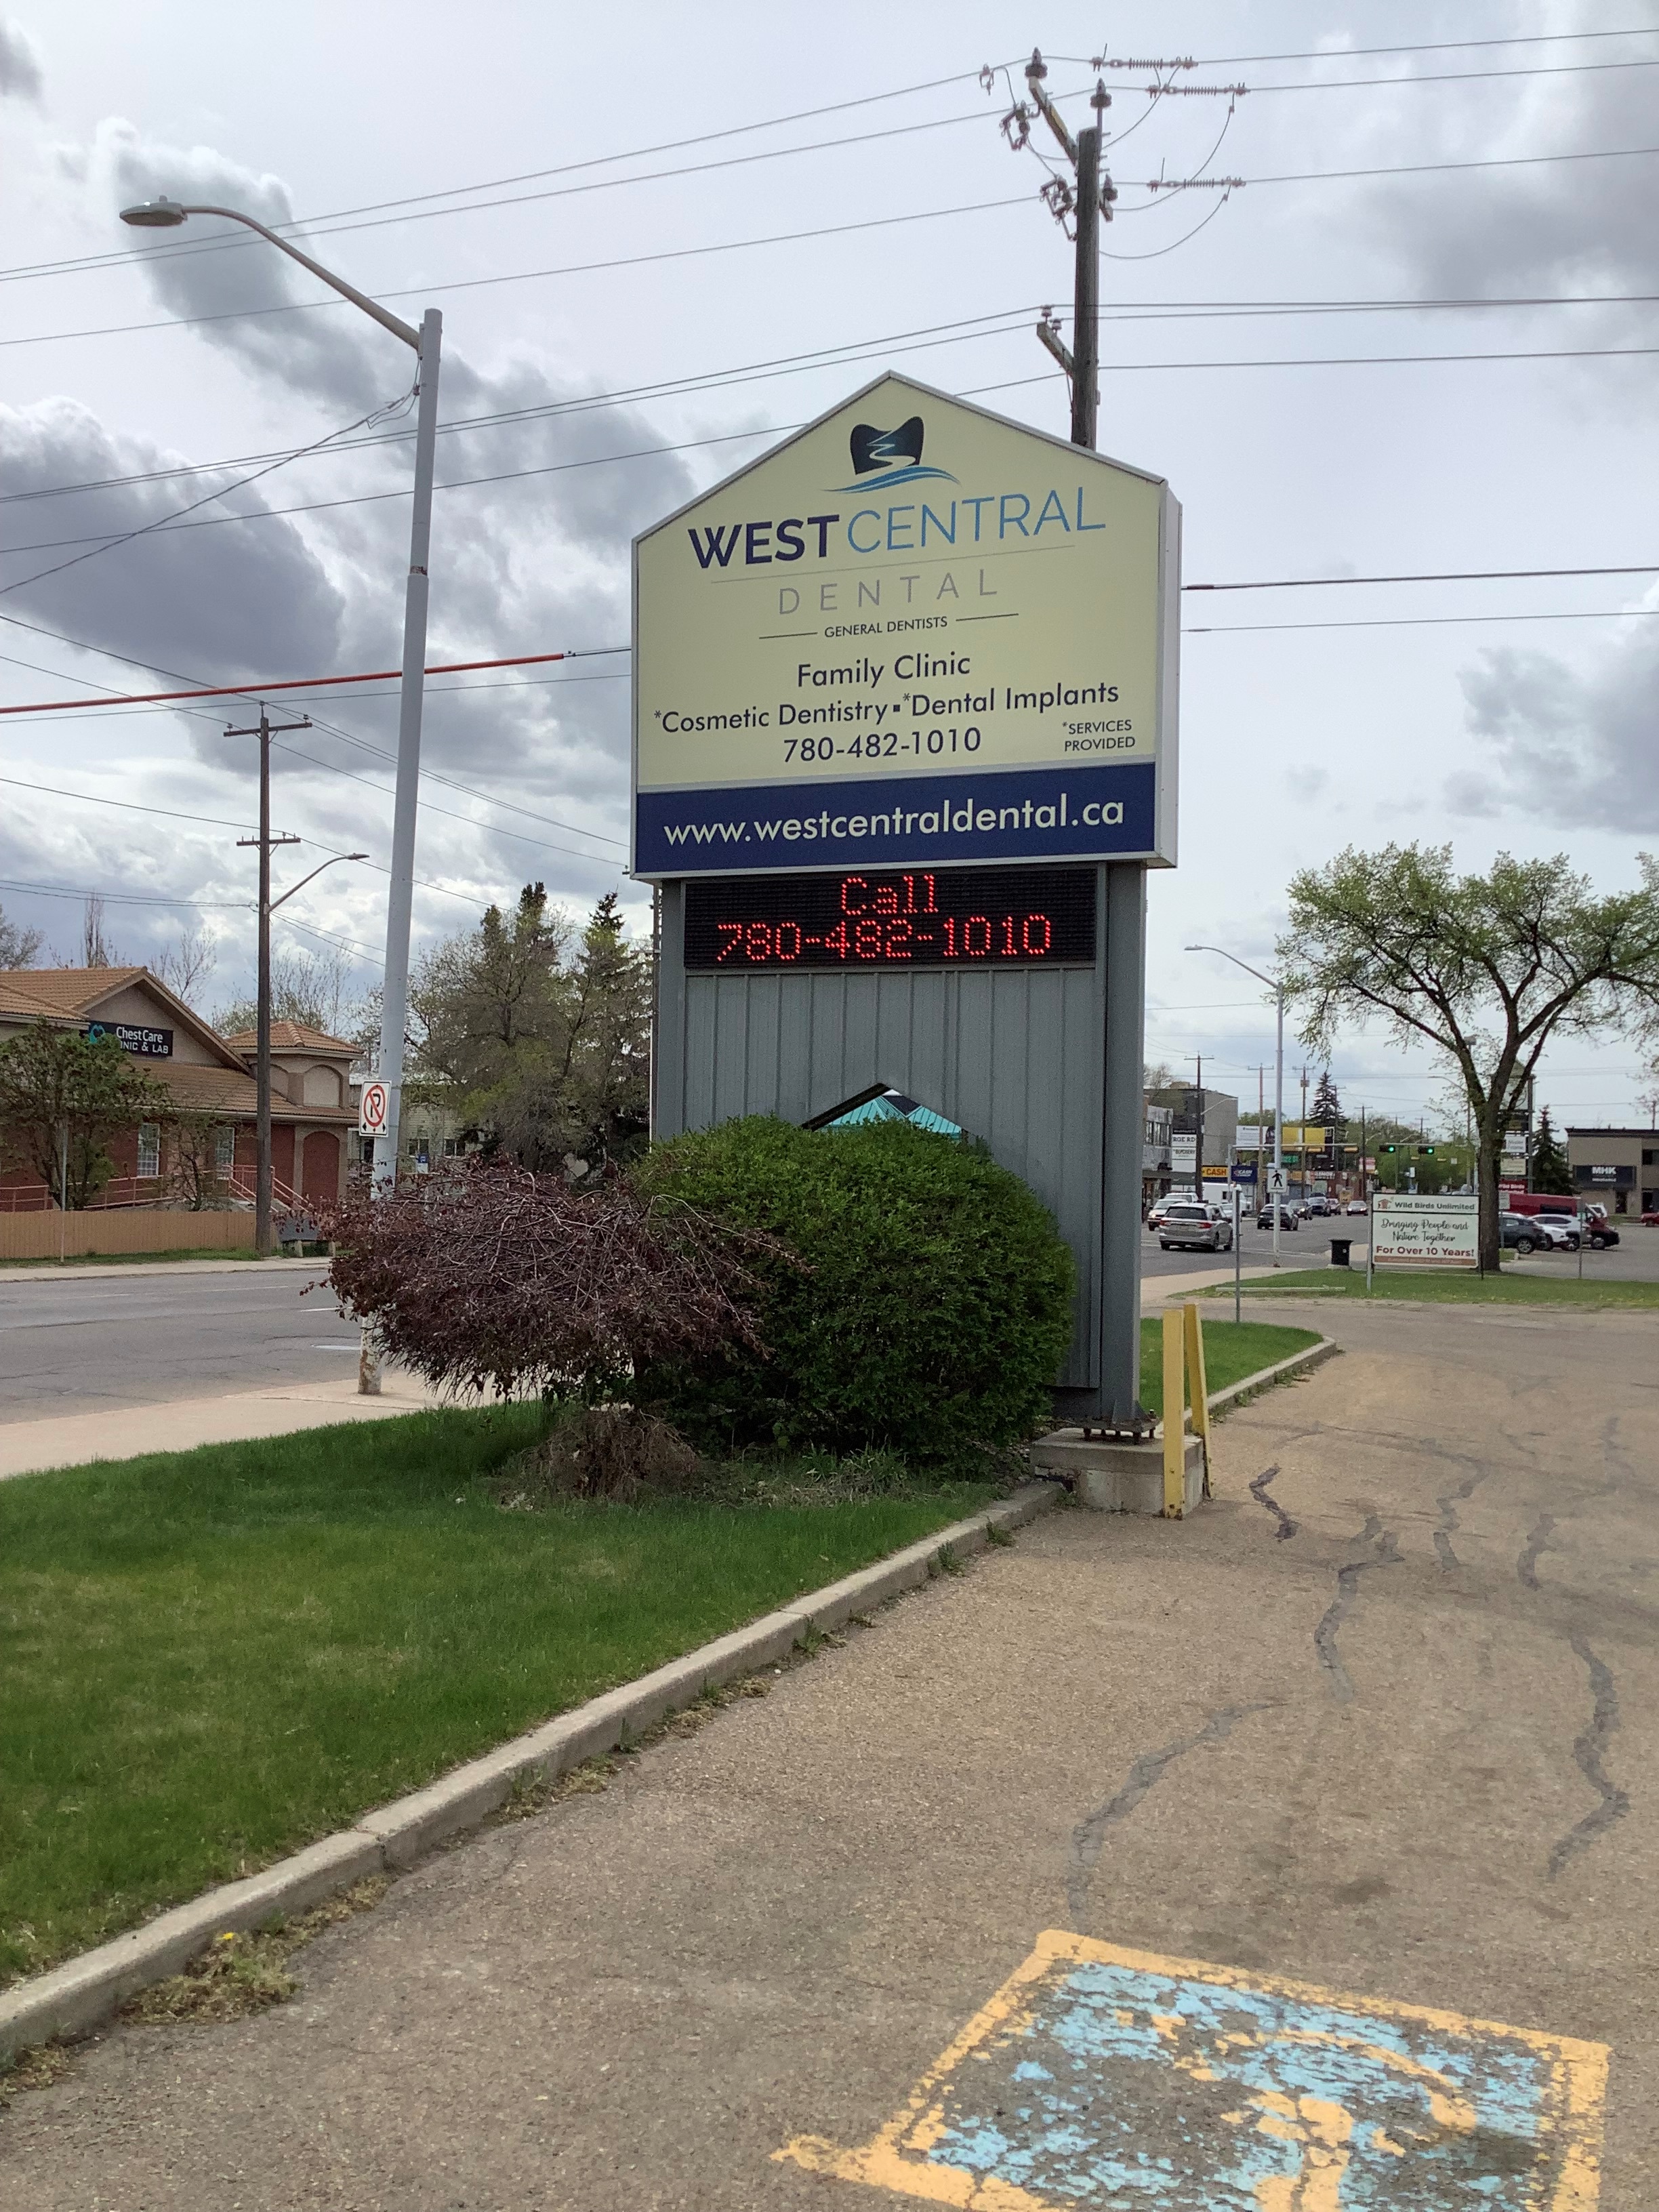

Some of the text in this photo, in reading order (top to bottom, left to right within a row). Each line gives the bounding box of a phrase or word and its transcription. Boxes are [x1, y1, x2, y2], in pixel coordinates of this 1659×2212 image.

[687, 486, 1106, 569] WEST CENTRAL
[778, 569, 998, 615] DENTAL
[825, 616, 947, 637] GENERAL DENTISTS
[798, 651, 970, 688] Family Clinic
[1007, 682, 1118, 713] Implants
[783, 728, 981, 762] 780-482-1010
[1065, 736, 1136, 752] PROVIDED
[663, 794, 1124, 846] www.westcentraldental.ca
[841, 874, 939, 916] Call
[718, 915, 1051, 960] 780-482-1010
[141, 1042, 149, 1052] &
[152, 1044, 169, 1054] LAB
[1592, 1166, 1617, 1175] MHK
[1380, 1218, 1469, 1232] Bringing People and
[1392, 1231, 1456, 1245] Nature Together
[1376, 1246, 1394, 1254] For
[1397, 1246, 1423, 1254] Over
[1441, 1248, 1475, 1257] Years!
